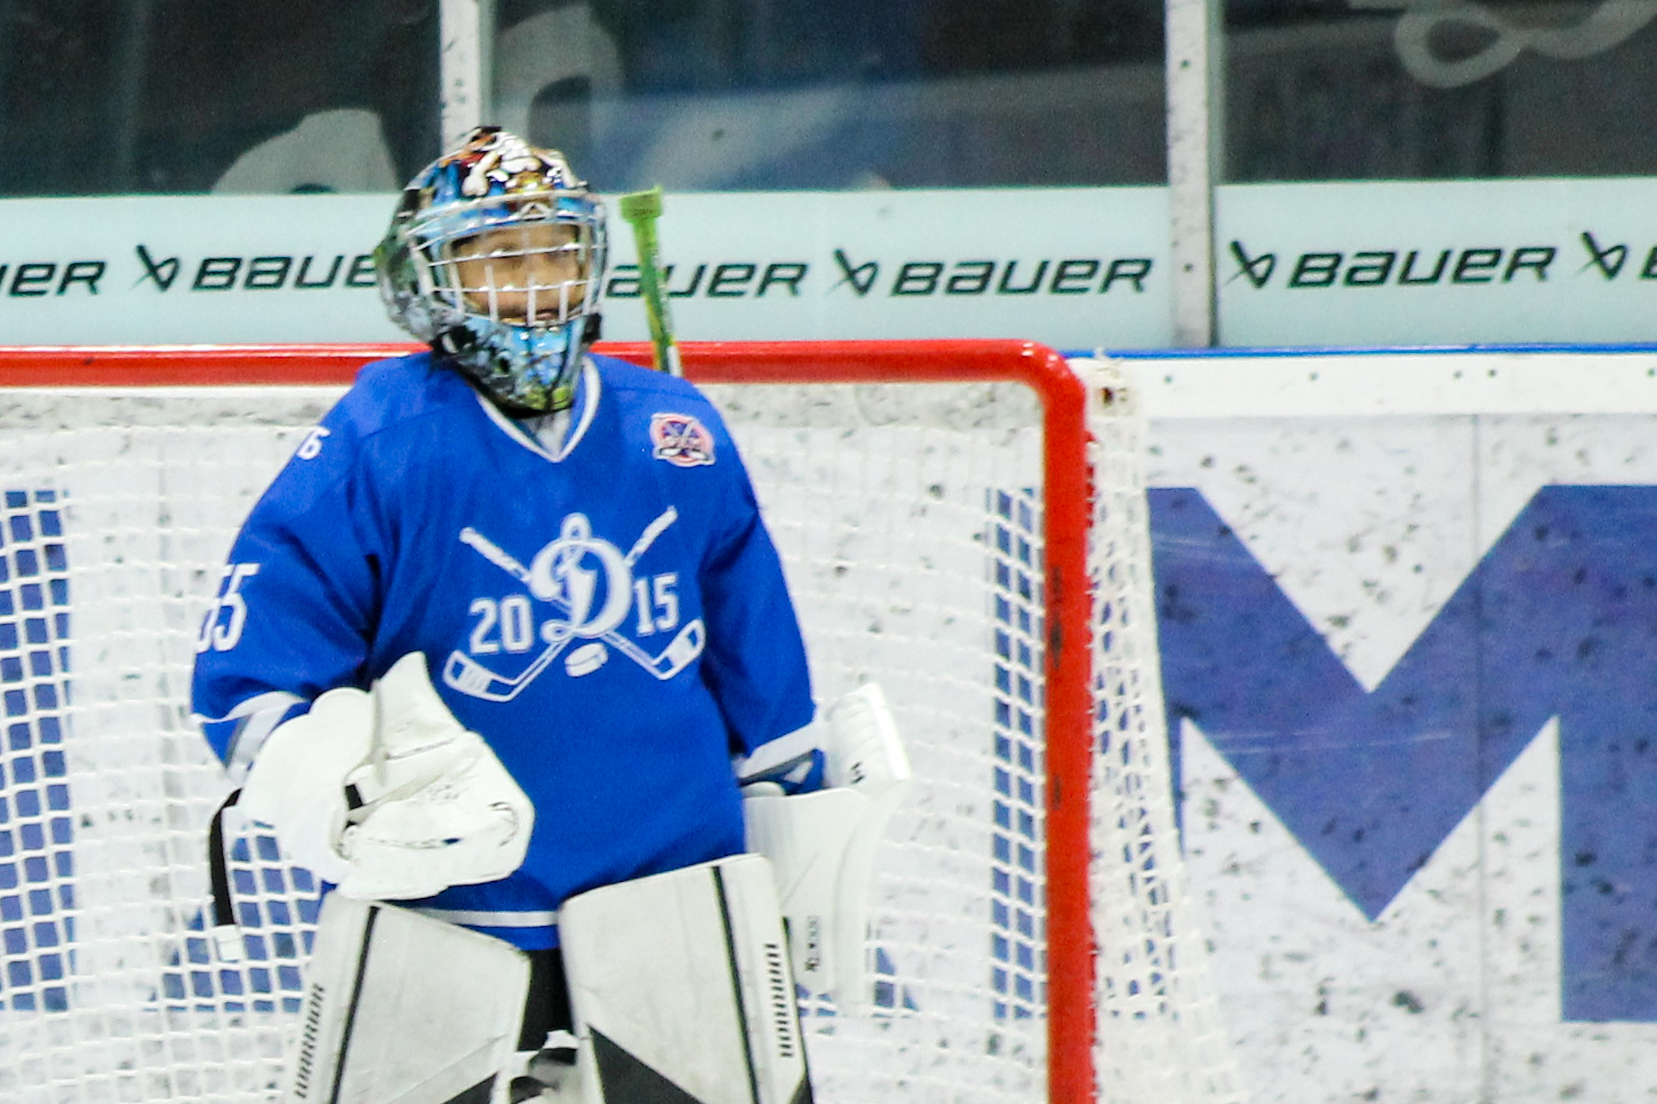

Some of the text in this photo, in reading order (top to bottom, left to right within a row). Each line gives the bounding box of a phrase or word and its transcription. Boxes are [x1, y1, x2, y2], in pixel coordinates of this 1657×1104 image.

[192, 253, 377, 291] BAUE
[605, 263, 809, 298] AUER
[890, 258, 1153, 297] BAUER
[1287, 246, 1558, 289] BAUER
